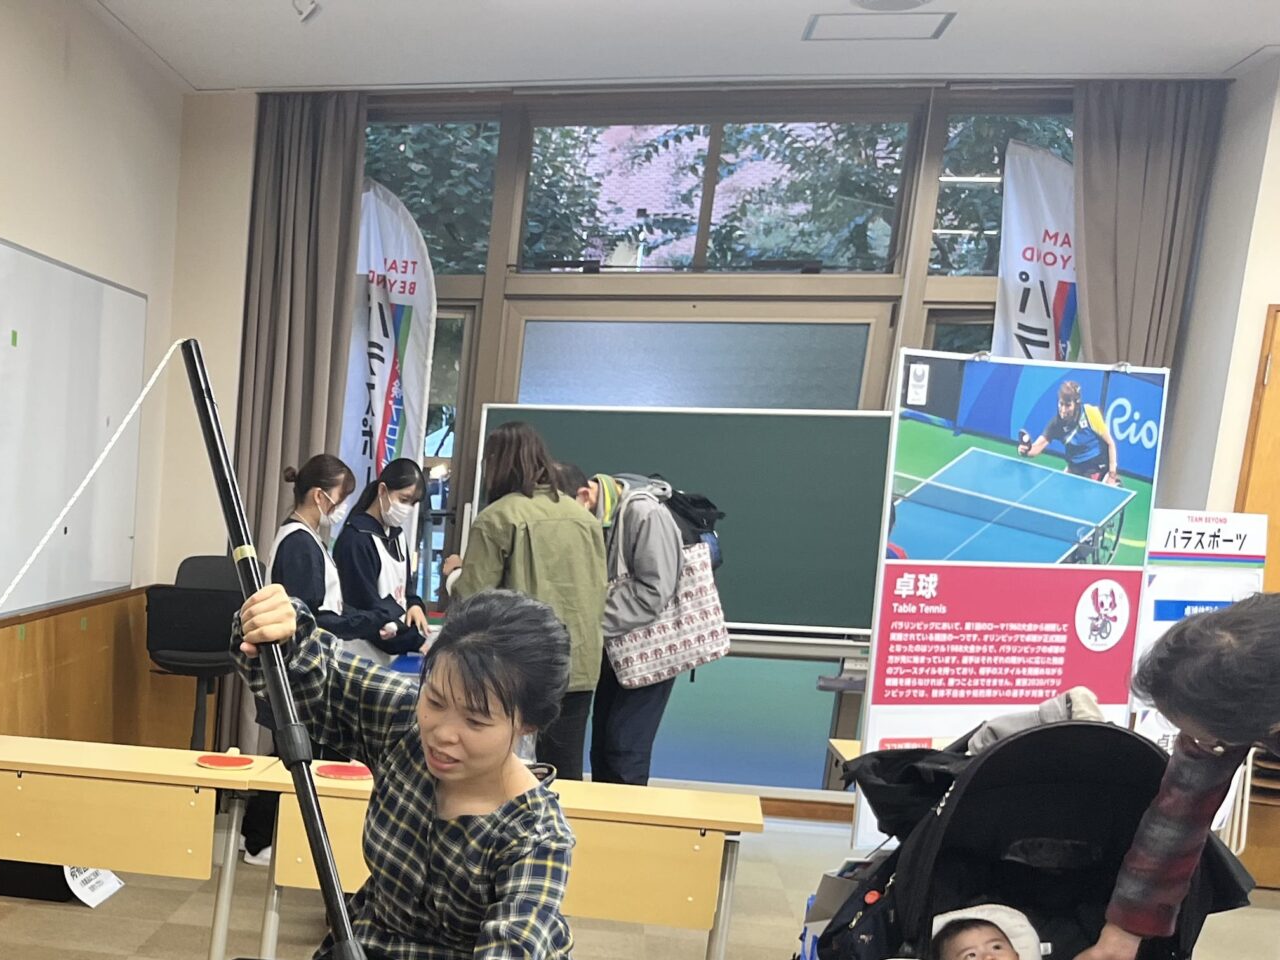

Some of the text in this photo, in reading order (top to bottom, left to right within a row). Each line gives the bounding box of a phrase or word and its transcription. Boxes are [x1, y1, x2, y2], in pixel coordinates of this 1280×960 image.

[1105, 397, 1158, 449] Rio
[1187, 515, 1228, 524] TEAM BEYOND
[1164, 527, 1248, 551] パラスポーツ
[894, 572, 939, 599] 卓球
[892, 603, 947, 614] Table Tennis
